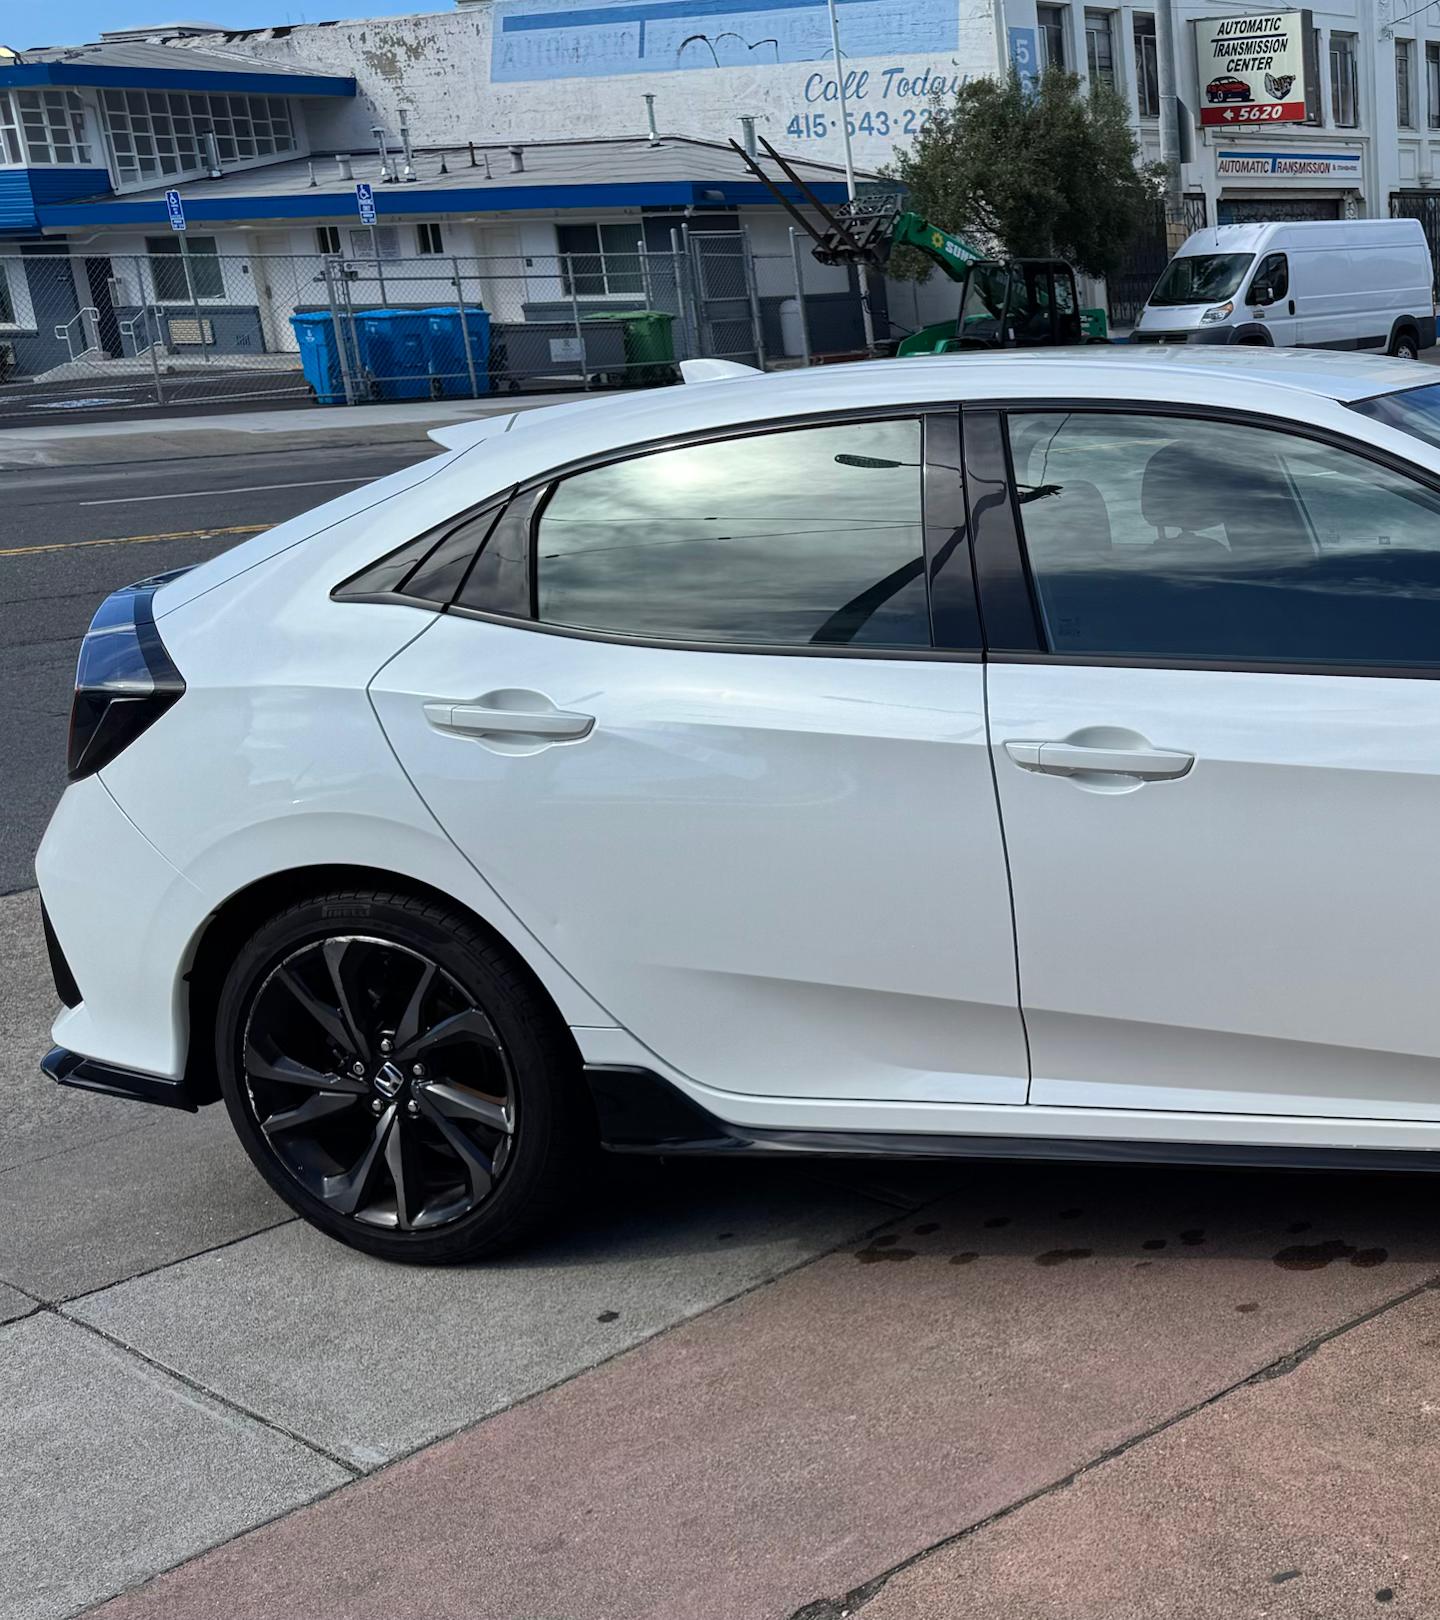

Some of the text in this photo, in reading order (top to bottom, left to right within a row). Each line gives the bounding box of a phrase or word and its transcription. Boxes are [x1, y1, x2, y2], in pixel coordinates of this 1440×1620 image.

[1217, 17, 1282, 36] AUTOMATIC
[1211, 33, 1288, 58] TRANSMISSION
[1226, 56, 1273, 73] CENTER
[805, 70, 869, 103] Call
[1238, 105, 1283, 120] 5620
[1218, 160, 1269, 173] AUTOMATIC
[1270, 157, 1330, 174] TRANSMISSION
